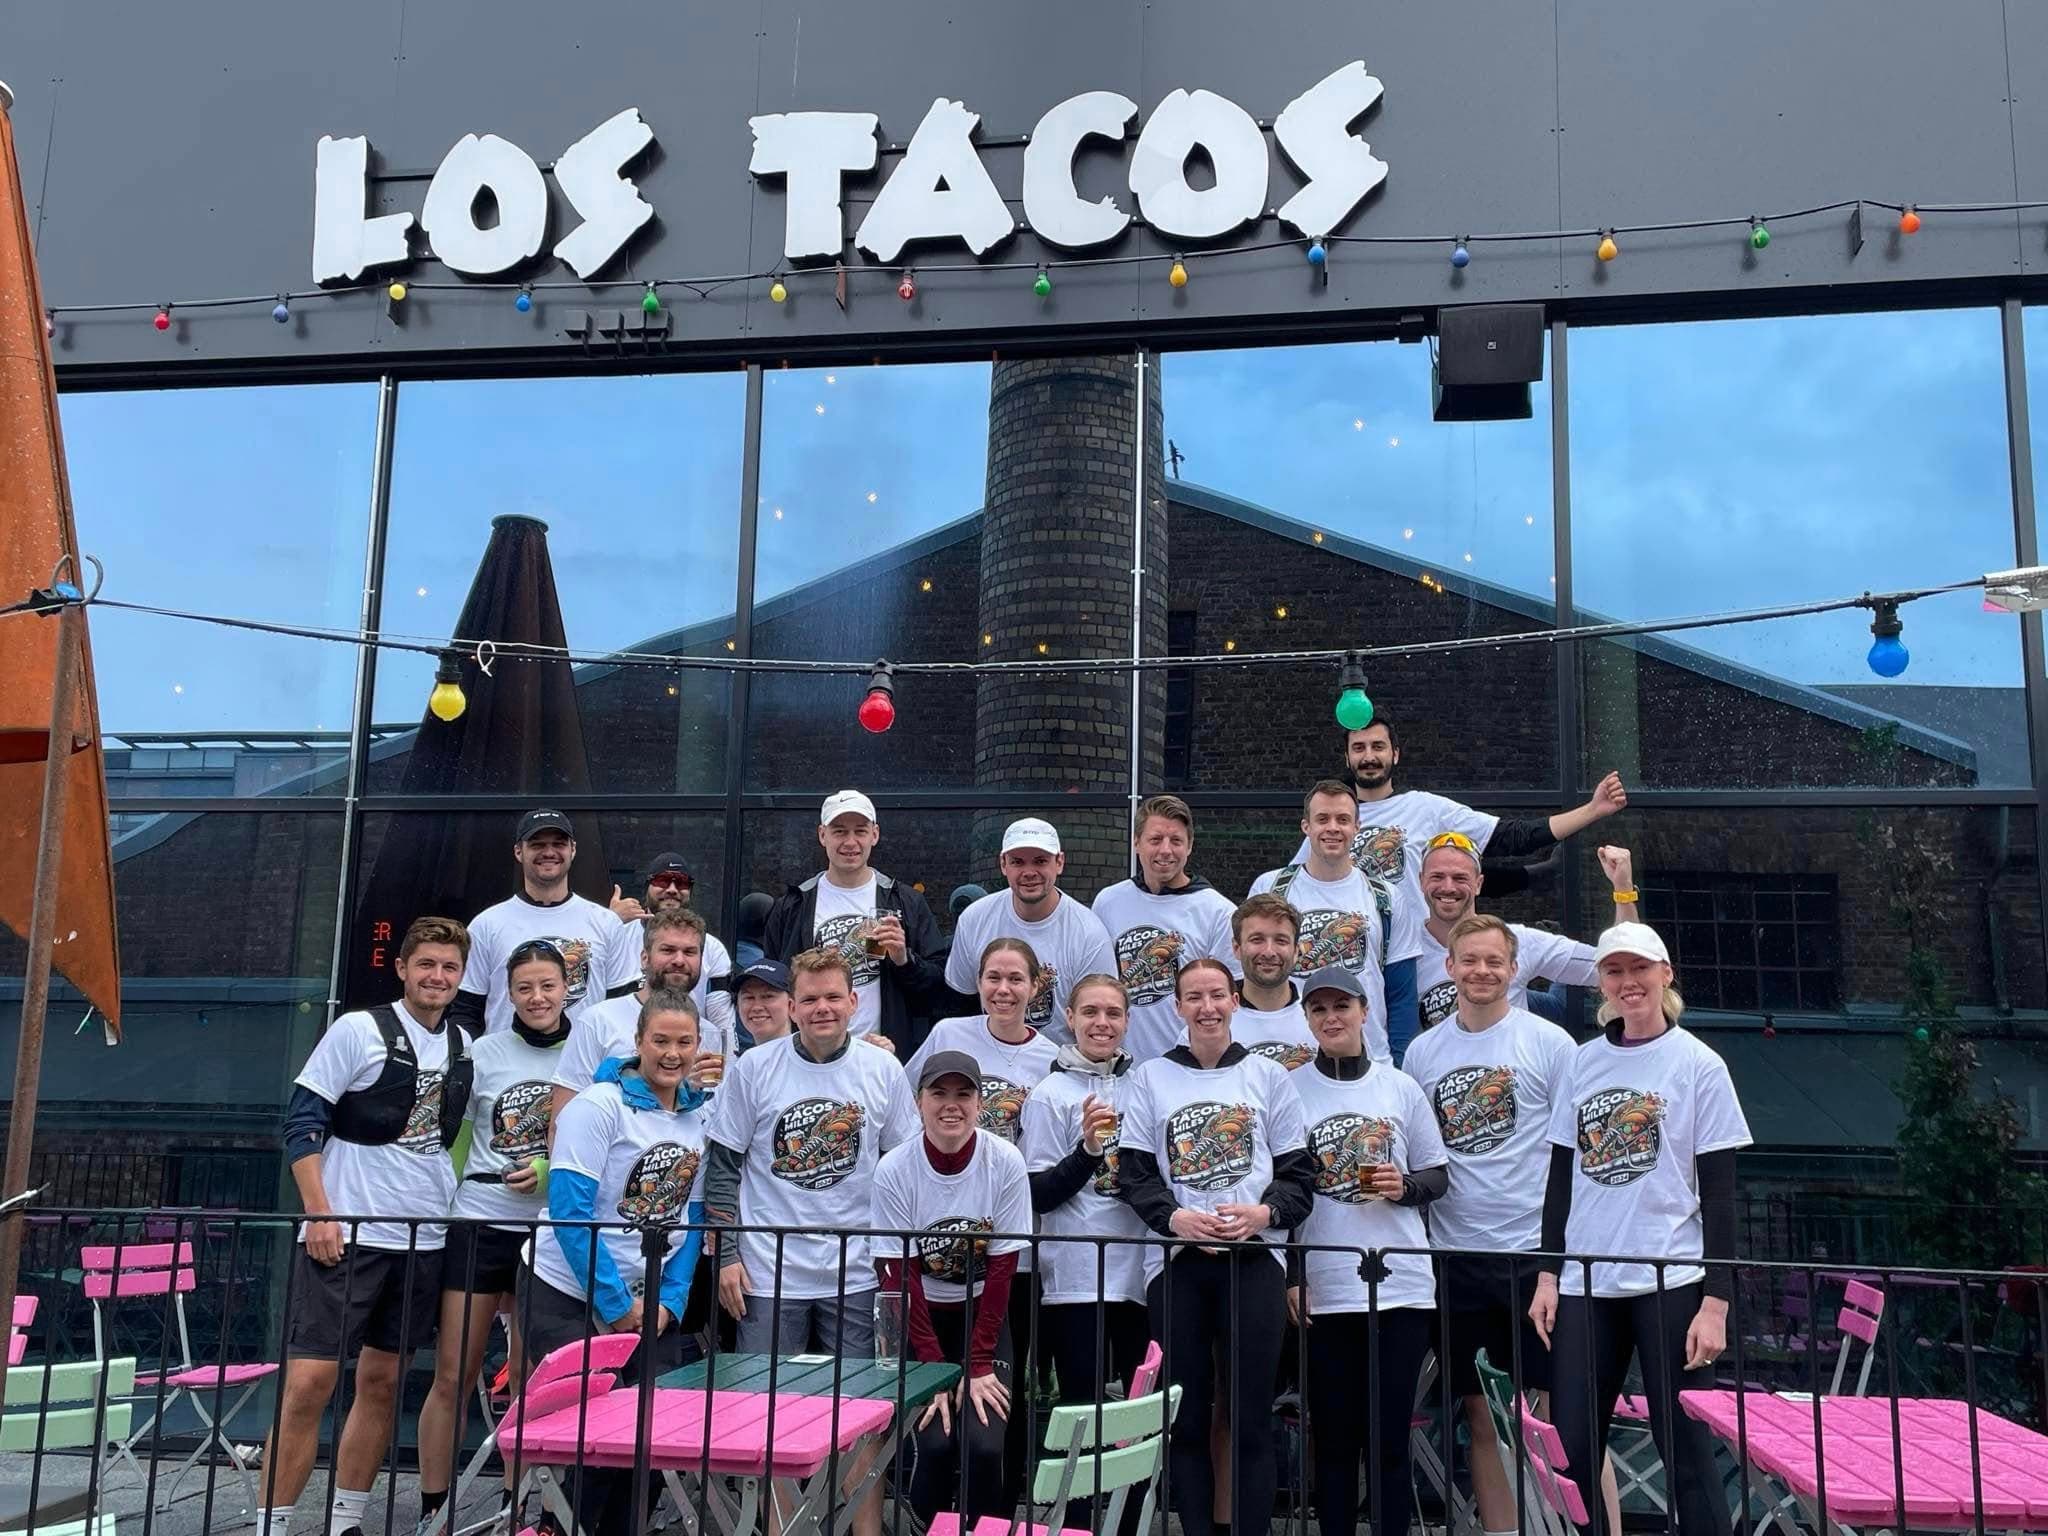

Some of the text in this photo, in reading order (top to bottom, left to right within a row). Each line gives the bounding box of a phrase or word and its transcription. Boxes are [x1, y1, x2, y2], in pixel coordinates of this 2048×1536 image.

[313, 60, 1389, 284] LOS TACOS
[819, 916, 863, 935] TACOS
[1301, 912, 1339, 927] ACOS
[821, 926, 848, 942] MILES
[1118, 929, 1159, 946] TACOS
[1119, 940, 1143, 953] MILES
[1423, 985, 1458, 1007] TACO
[1438, 1068, 1485, 1093] TACOS
[501, 1085, 552, 1102] TACOS
[1440, 1083, 1468, 1101] MILES
[502, 1095, 533, 1109] MILES
[1580, 1091, 1632, 1115] TACOS
[783, 1102, 833, 1123] TACOS
[1171, 1105, 1221, 1126] TACOS
[1583, 1105, 1611, 1123] MILES
[784, 1115, 816, 1132] MILES
[1173, 1117, 1204, 1134] MILES
[1313, 1117, 1364, 1139] TACOS
[1315, 1129, 1346, 1146] MILES
[643, 1147, 684, 1165] TACOS
[641, 1159, 672, 1173] MILES
[922, 1237, 952, 1255] MILES
